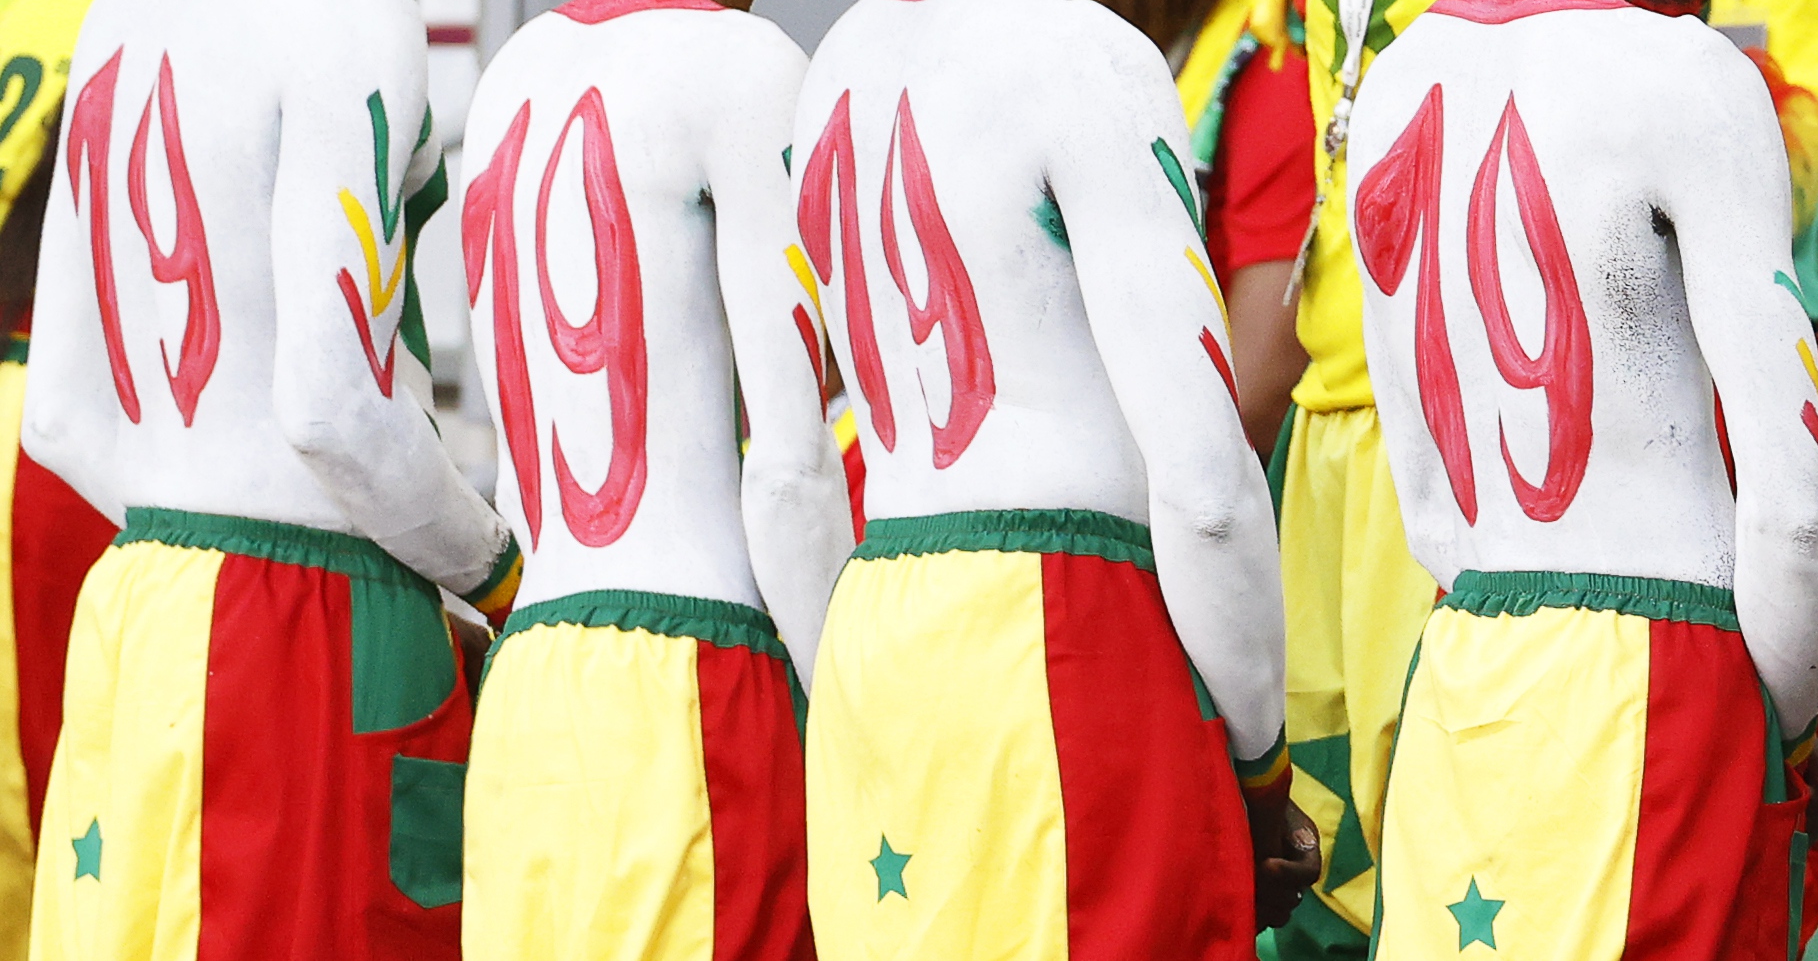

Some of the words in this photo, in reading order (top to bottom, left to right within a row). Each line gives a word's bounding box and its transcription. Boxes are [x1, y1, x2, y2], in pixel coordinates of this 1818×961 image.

[67, 43, 221, 428] 19
[461, 85, 648, 552] 19
[798, 86, 995, 470] 19
[1355, 83, 1593, 527] 19
